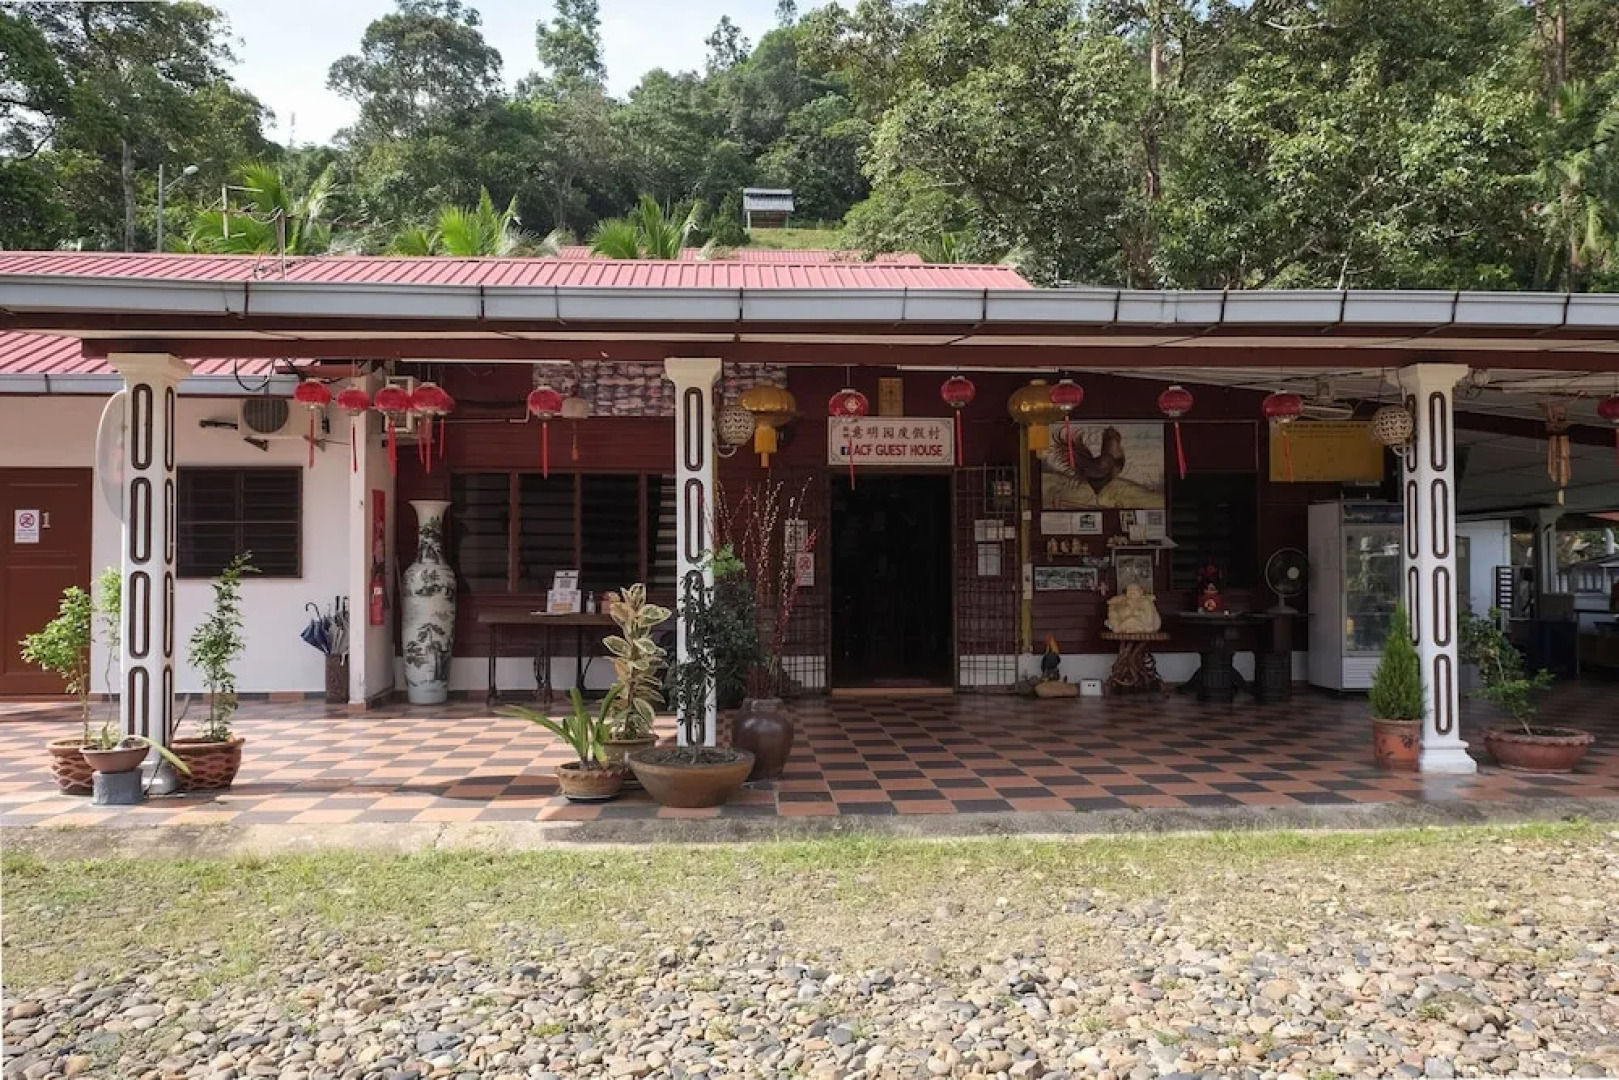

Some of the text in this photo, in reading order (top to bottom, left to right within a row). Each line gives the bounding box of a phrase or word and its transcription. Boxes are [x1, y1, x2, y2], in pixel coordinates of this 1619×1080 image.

[853, 444, 872, 456] ACF
[875, 444, 907, 456] GUEST
[910, 444, 943, 456] HOUSE
[42, 511, 50, 528] 1
